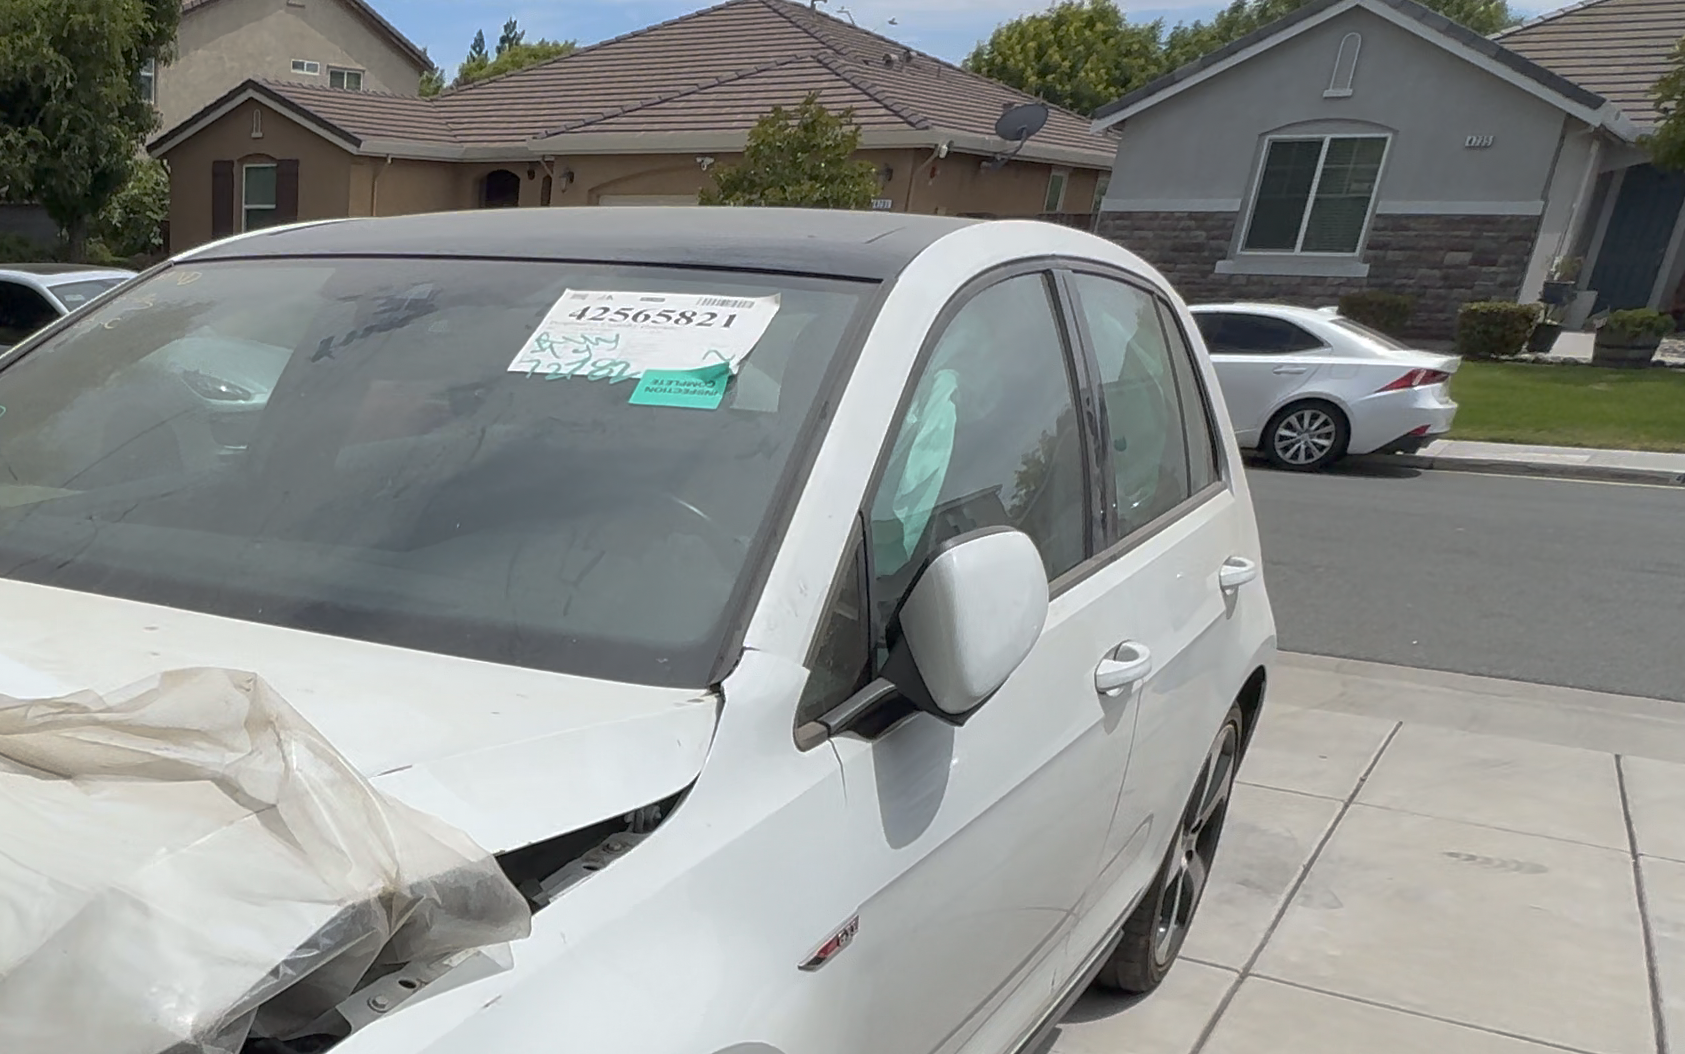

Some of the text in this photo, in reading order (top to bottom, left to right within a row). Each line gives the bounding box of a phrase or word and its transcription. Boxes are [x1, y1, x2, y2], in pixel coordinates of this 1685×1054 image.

[568, 305, 738, 329] 42565821
[650, 379, 716, 389] COMPLETE
[644, 386, 720, 397] INSPECTION
